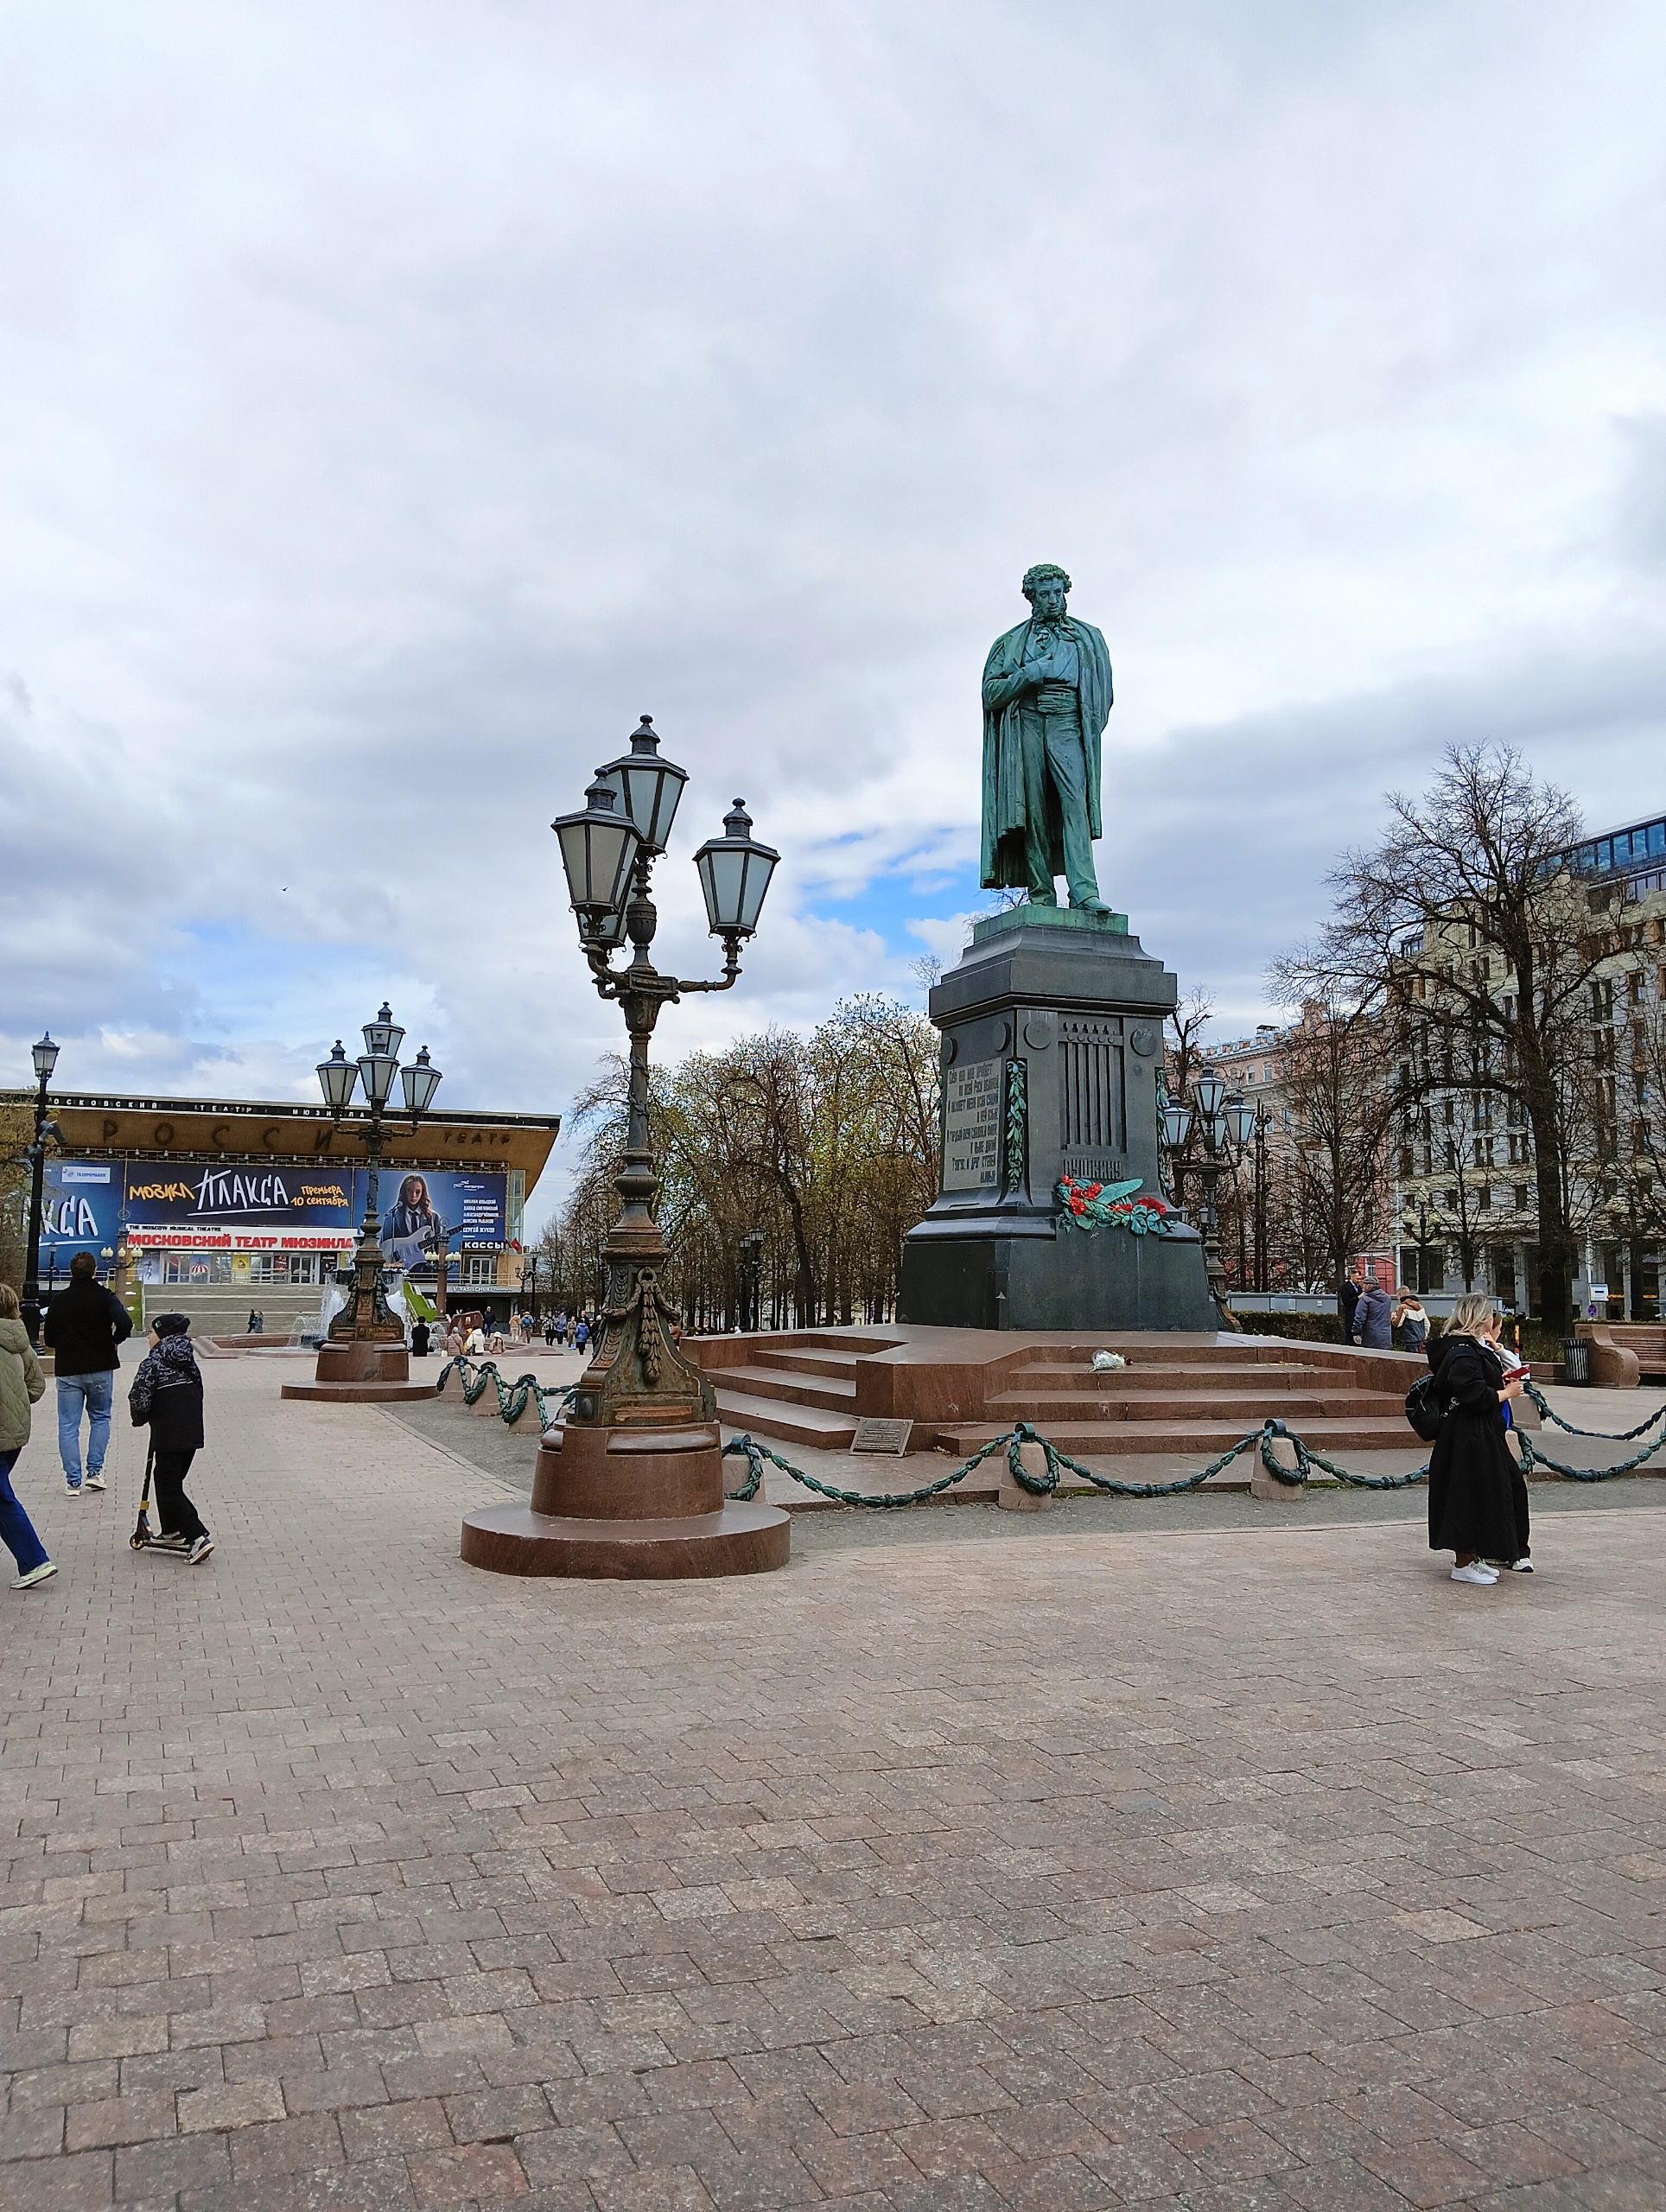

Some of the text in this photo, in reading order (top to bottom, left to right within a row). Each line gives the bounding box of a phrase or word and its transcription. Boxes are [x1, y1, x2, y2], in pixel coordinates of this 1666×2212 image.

[49, 1097, 366, 1119] ОСКОВСКИЙ ТЕАТР МЮЗИЛА
[102, 1119, 334, 1153] РОССИ
[444, 1131, 511, 1145] ТЕАТР
[190, 1168, 289, 1210] ПЛАКСА
[290, 1196, 304, 1207] 10
[128, 1233, 354, 1249] МОСКОВСКИЙ ТЕАТР МЮЗИКЛА
[464, 1241, 505, 1249] кассы
